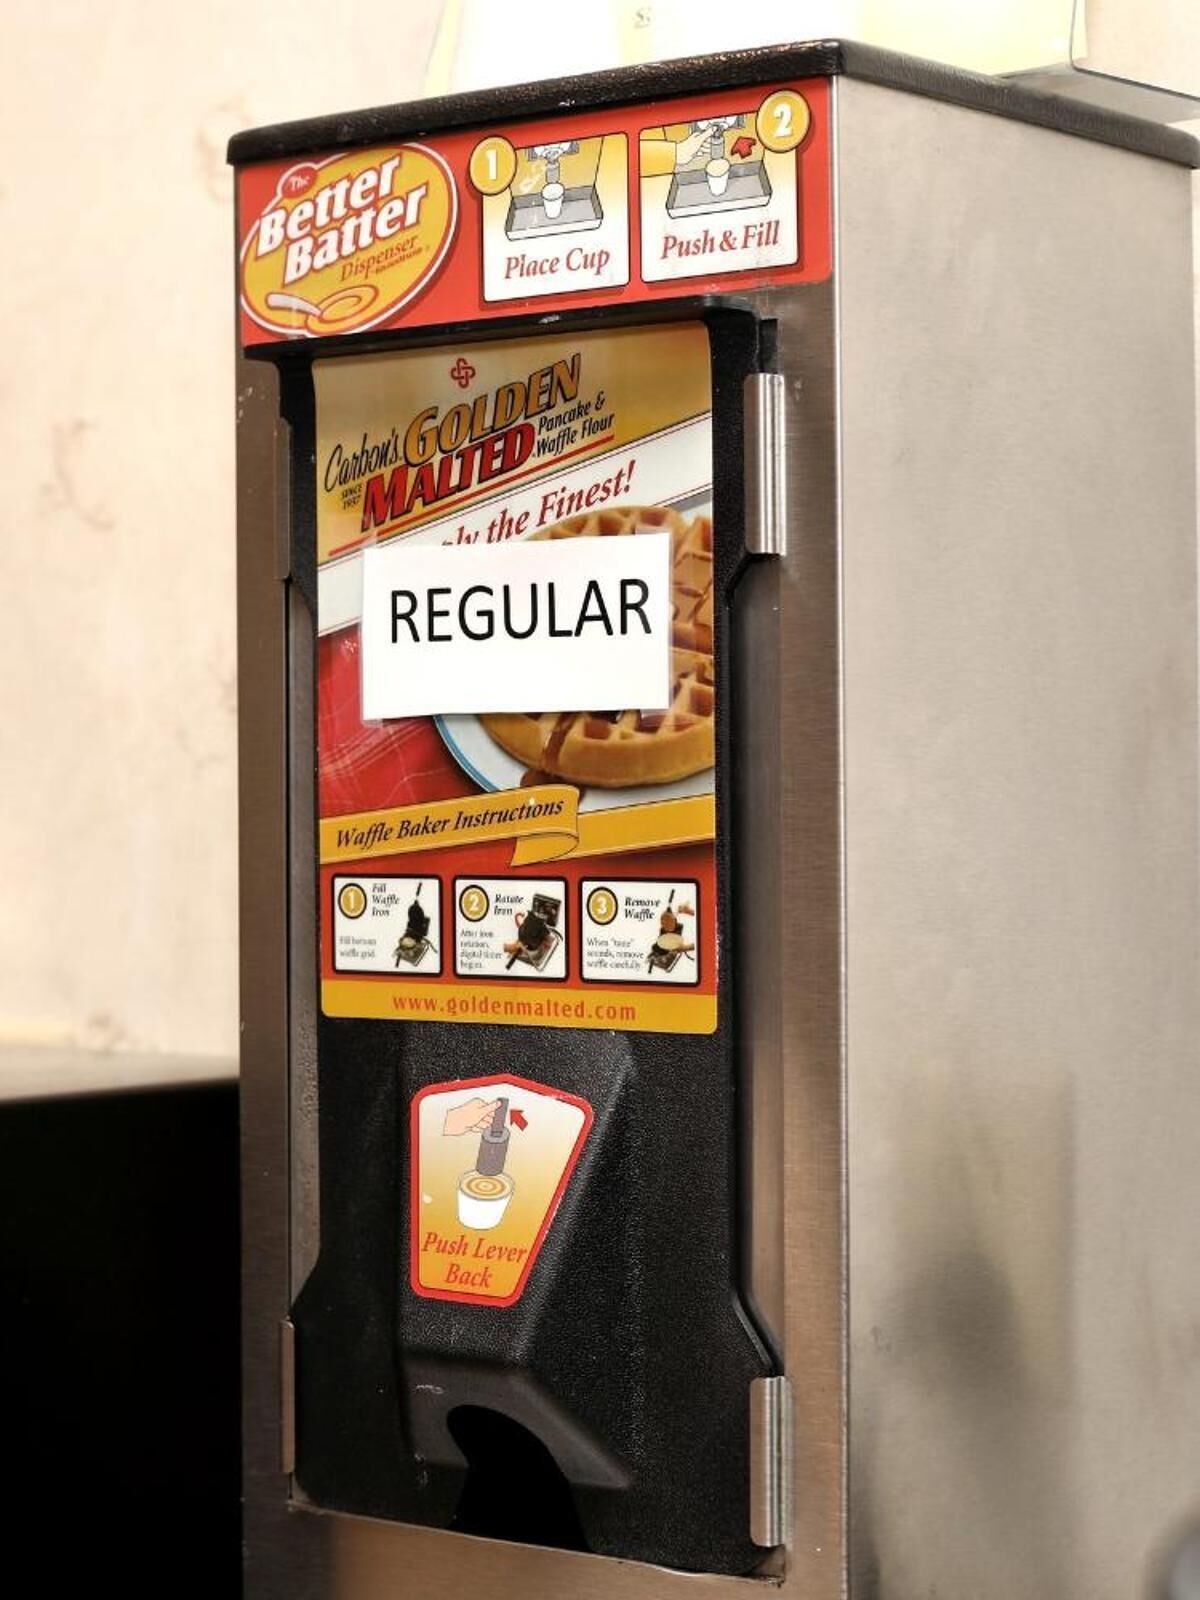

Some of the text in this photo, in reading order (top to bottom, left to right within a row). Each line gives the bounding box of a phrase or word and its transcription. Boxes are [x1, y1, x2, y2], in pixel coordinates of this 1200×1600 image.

[773, 104, 793, 138] 2
[290, 175, 310, 191] The
[486, 151, 497, 180] 1
[256, 155, 401, 259] Better
[284, 183, 428, 286] Batter
[661, 220, 780, 260] Push & Fill
[341, 235, 419, 281] Dispenser
[505, 247, 610, 279] Place Cup
[324, 352, 581, 493] Carbon's GOLDEN
[538, 391, 606, 435] Pancake &
[537, 414, 615, 457] Waffle Flour
[361, 421, 536, 533] MALTED
[487, 508, 530, 544] the
[536, 459, 636, 527] Finest!
[391, 579, 651, 644] REGULAR
[337, 799, 564, 850] Waffle Baker Instructions
[372, 883, 387, 893] Fill
[624, 897, 660, 907] Remove
[624, 908, 655, 922] Waffle
[392, 994, 636, 1022] www.goldenmalted.com
[422, 1231, 527, 1262] Push Lever
[444, 1263, 492, 1288] Back
